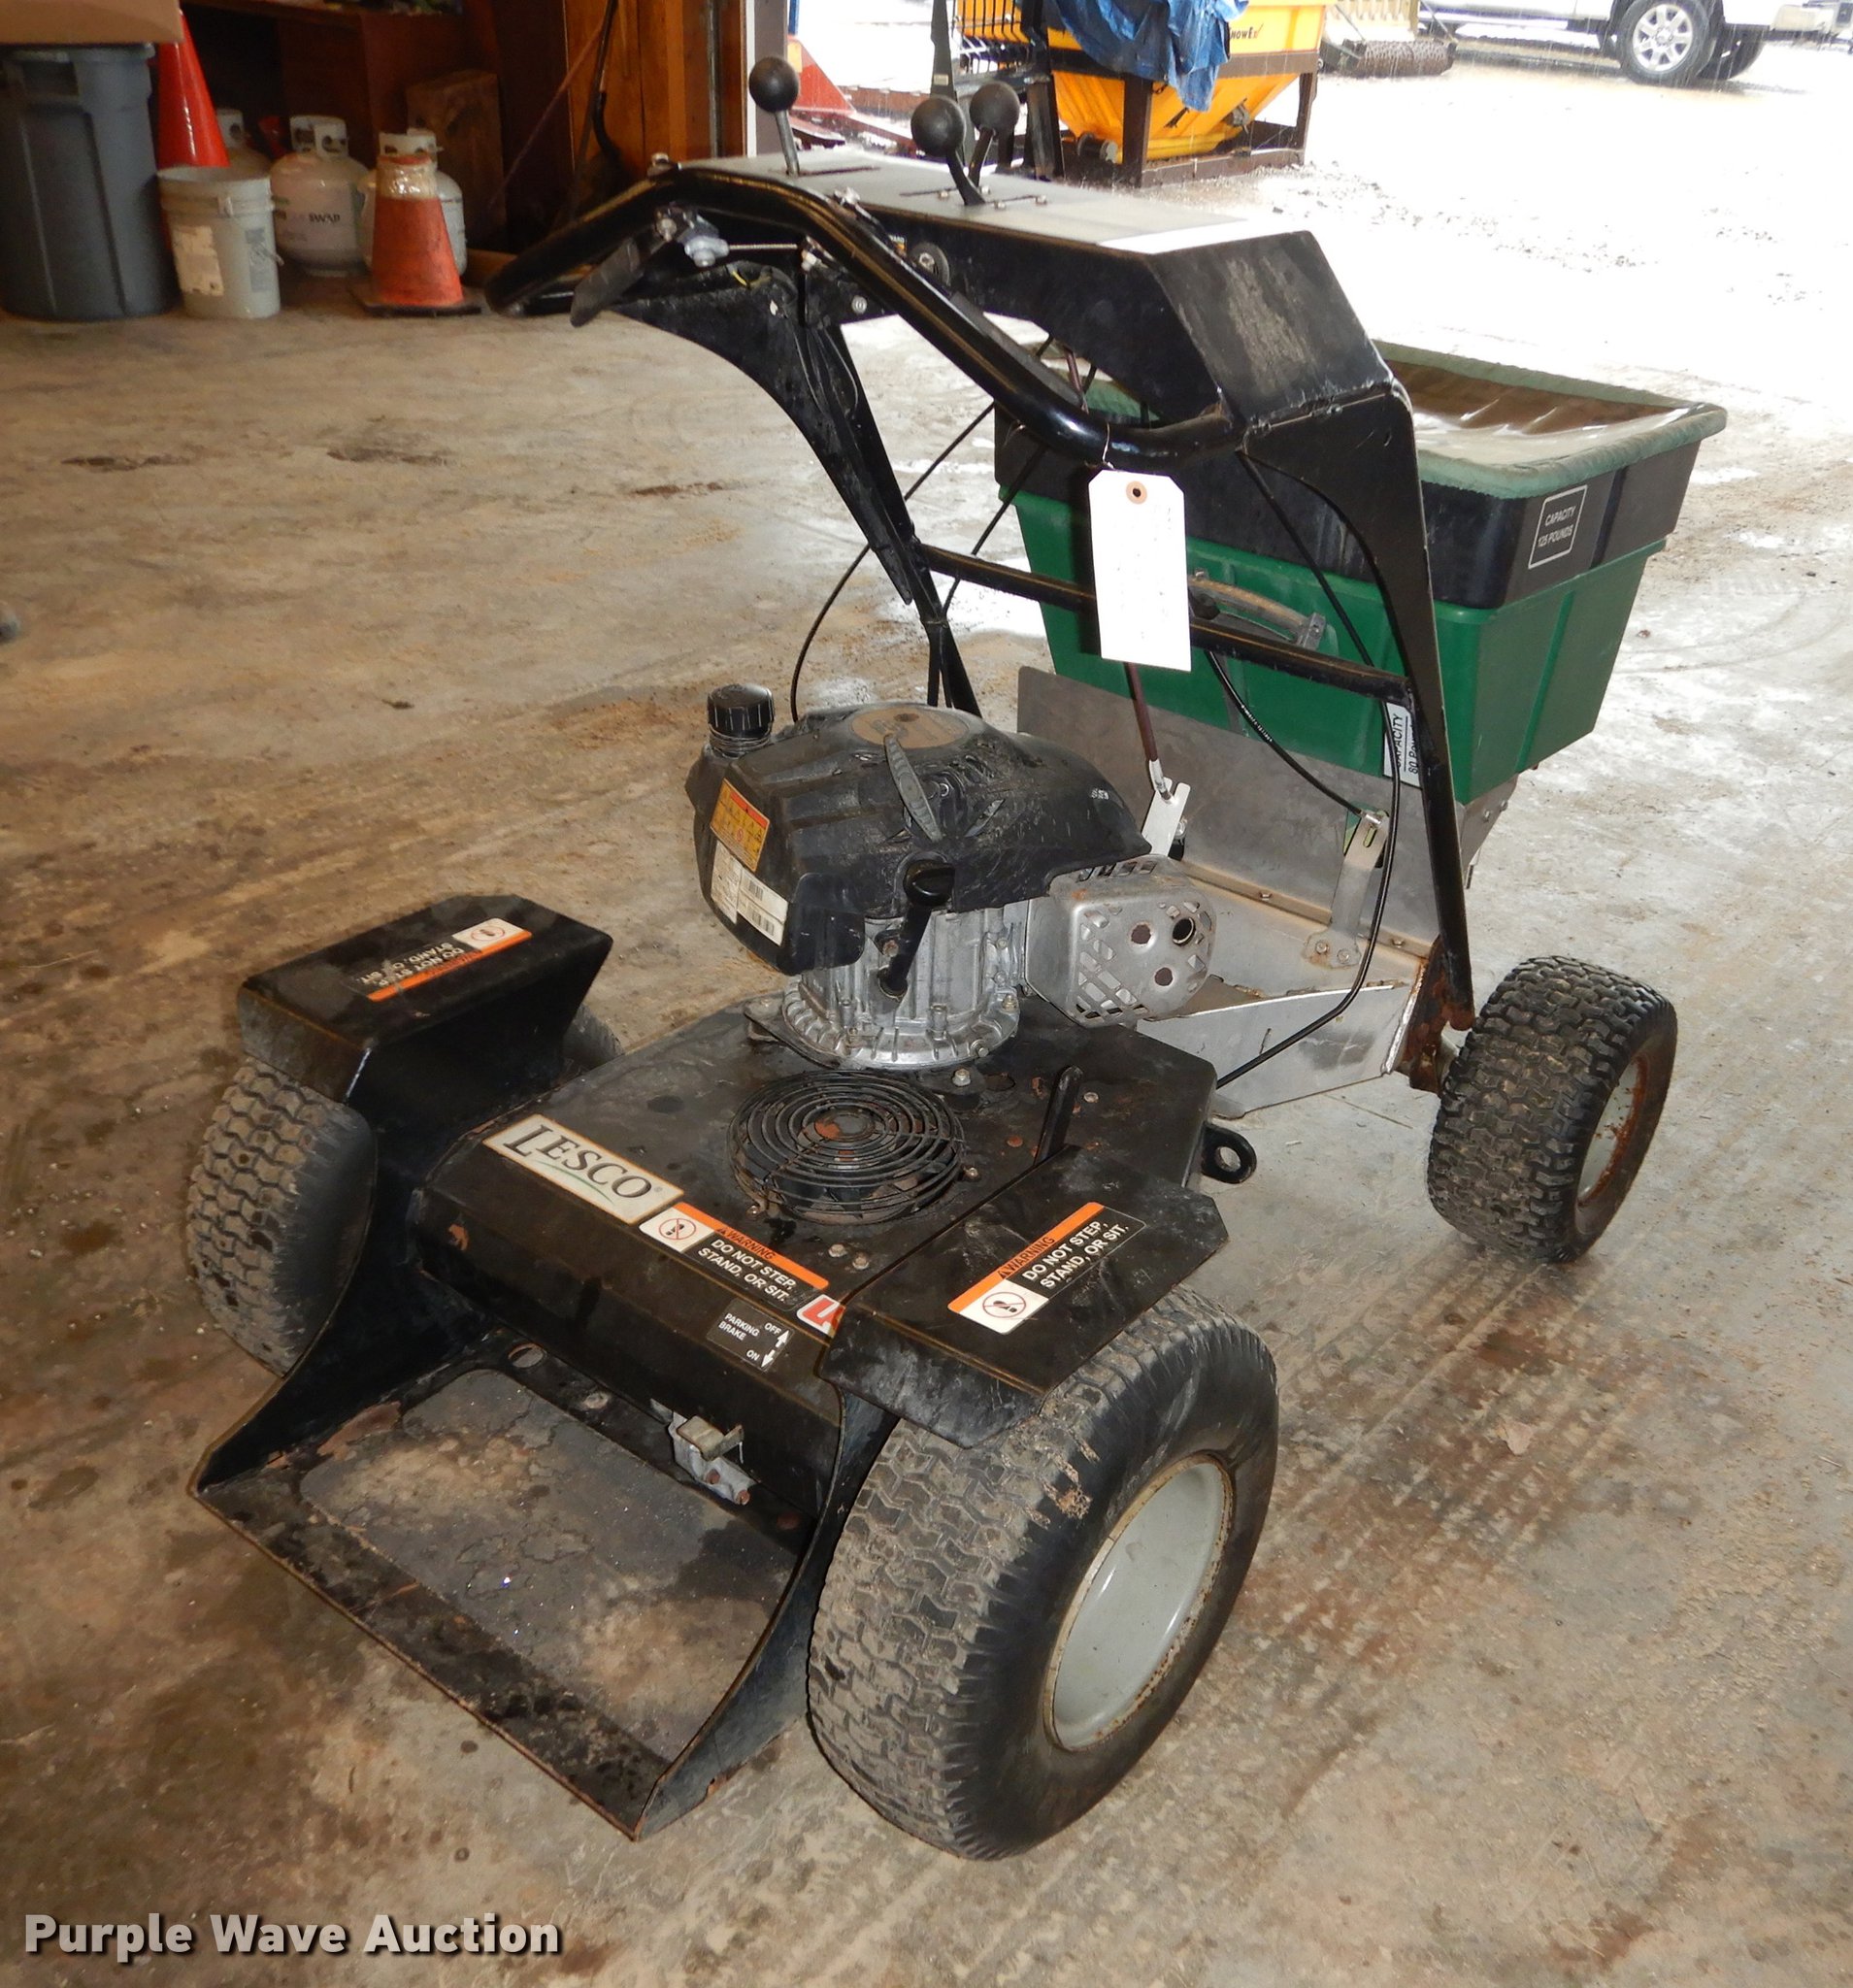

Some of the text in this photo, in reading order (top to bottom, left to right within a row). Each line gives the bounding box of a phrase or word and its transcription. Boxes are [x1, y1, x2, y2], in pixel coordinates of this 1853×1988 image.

[1544, 506, 1576, 527] CAPACITY
[1548, 524, 1573, 544] POUNDS
[1408, 762, 1418, 775] 80
[415, 956, 443, 971] NOT
[442, 947, 465, 959] DO
[503, 1124, 652, 1198] LESCO
[726, 1230, 776, 1260] WARNING
[1005, 1236, 1056, 1273] WARNING
[1022, 1221, 1108, 1281] DO NOT STEP,
[1040, 1224, 1130, 1289] STAND, OR SIT.
[698, 1247, 789, 1302] STAND, OR SIT.
[711, 1239, 798, 1290] DO NOT STEP,
[718, 1321, 747, 1342] BRAKE
[724, 1312, 782, 1338] PARKING OFF
[746, 1349, 761, 1361] ON
